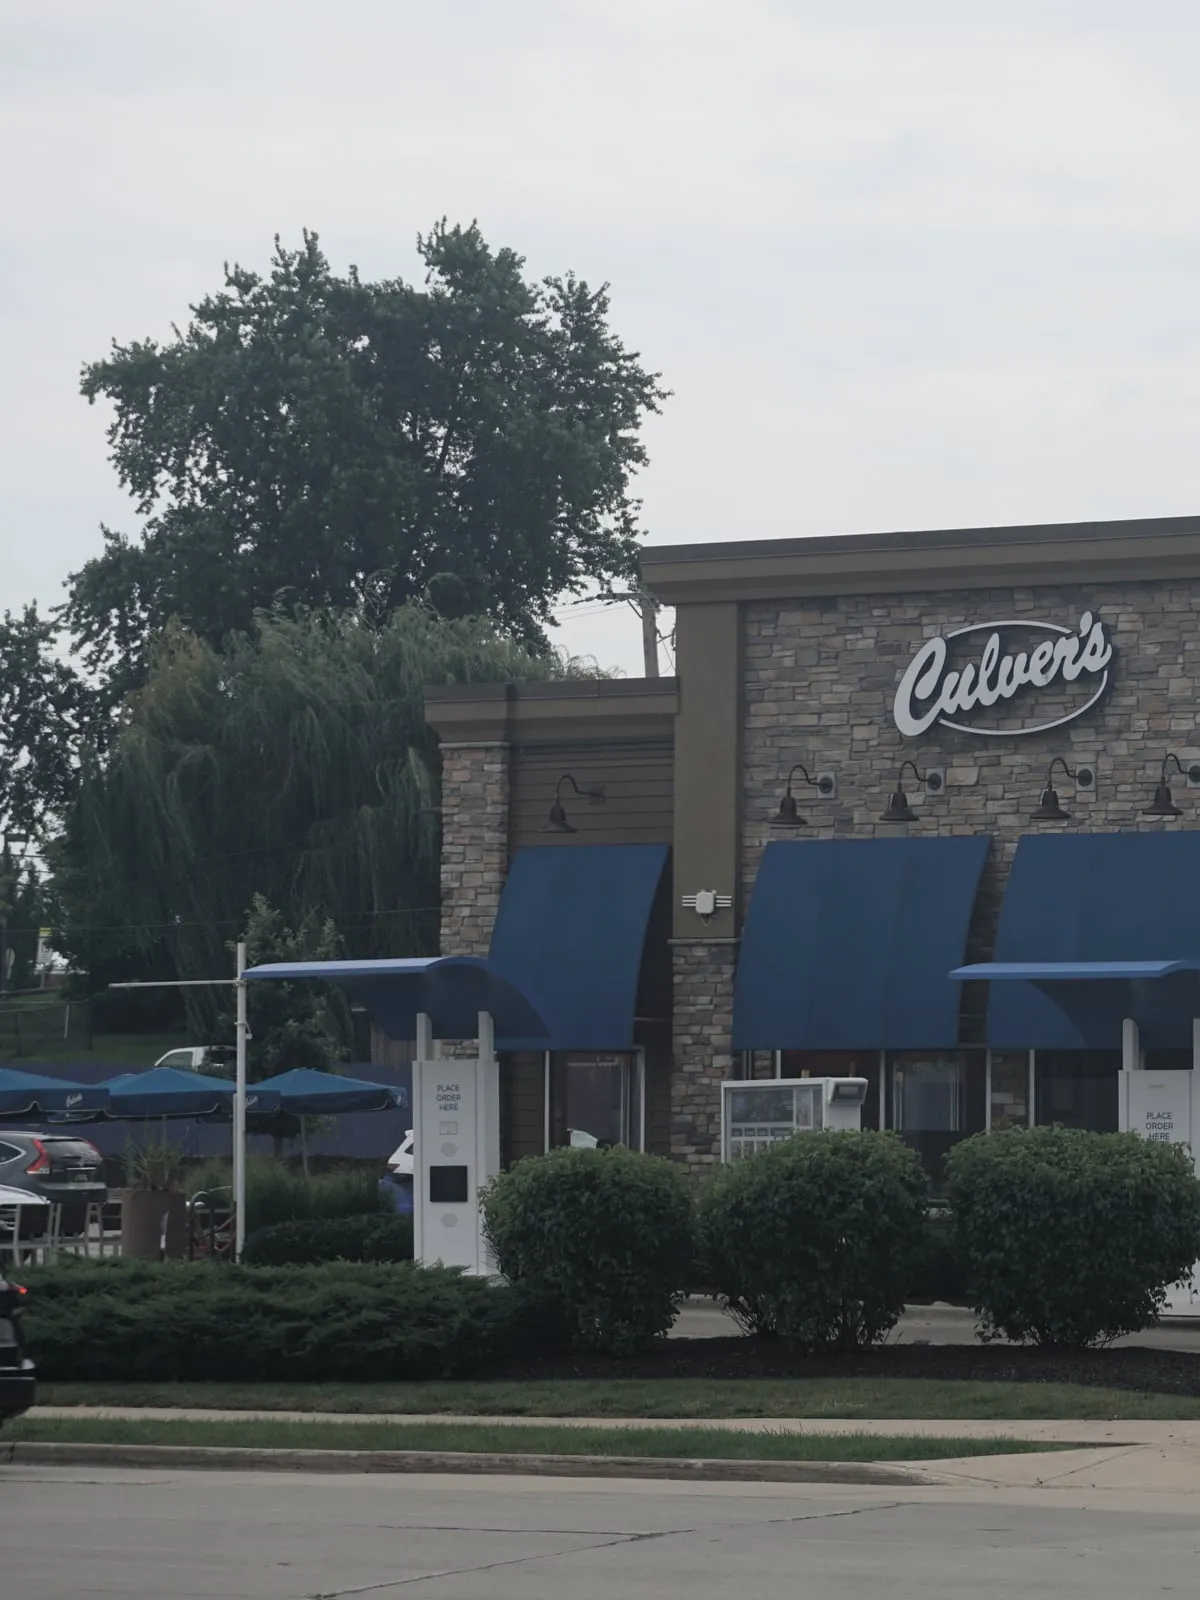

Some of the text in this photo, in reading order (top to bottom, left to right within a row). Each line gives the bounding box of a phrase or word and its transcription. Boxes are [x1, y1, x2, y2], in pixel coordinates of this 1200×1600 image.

[893, 610, 1112, 736] Culver's
[437, 1084, 460, 1092] PLACE
[1145, 1122, 1173, 1130] ORDER
[1148, 1132, 1170, 1140] HERE
